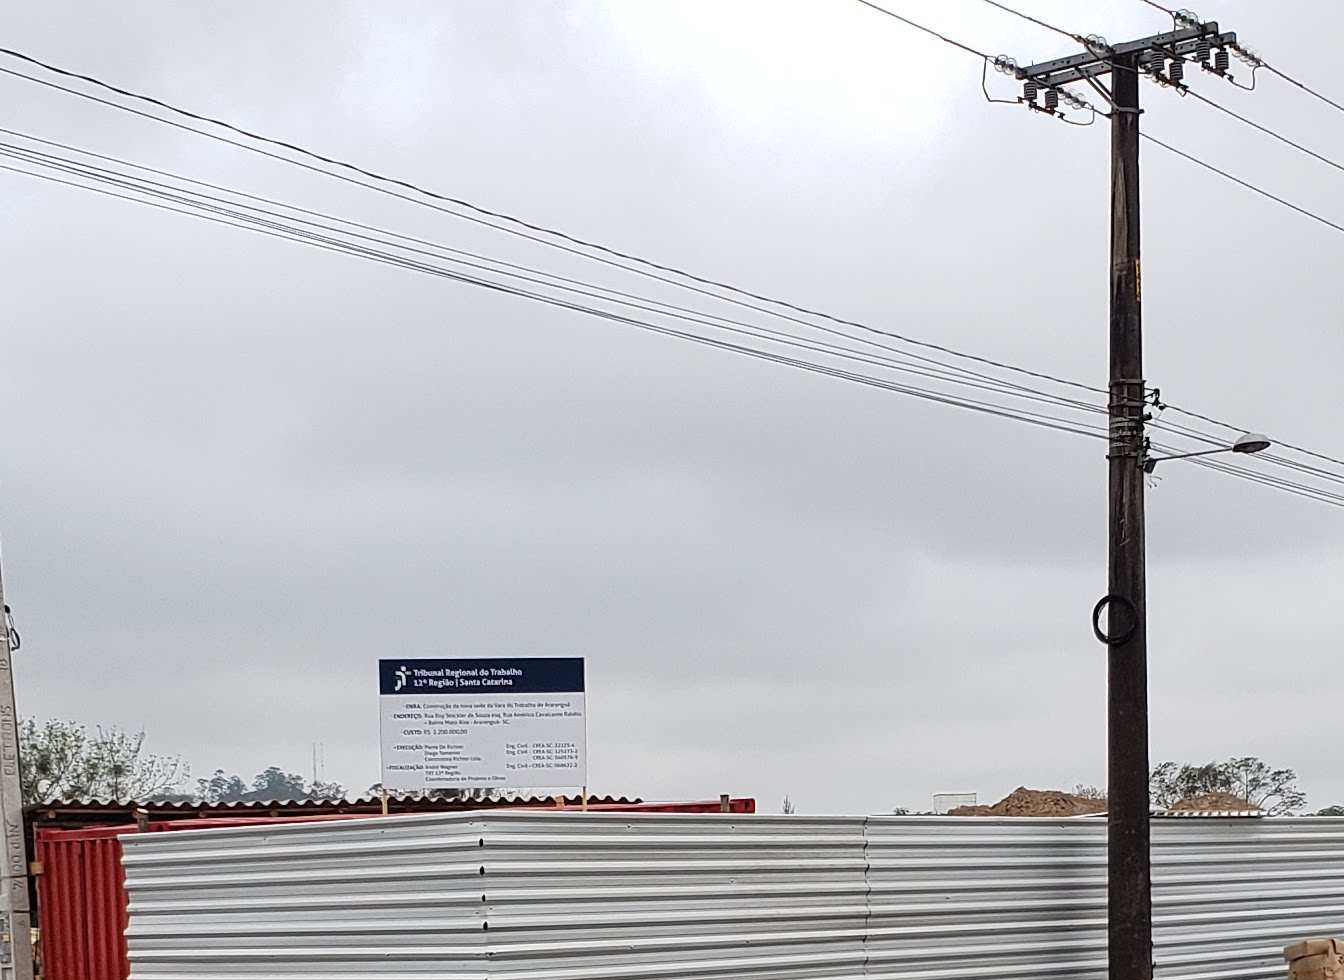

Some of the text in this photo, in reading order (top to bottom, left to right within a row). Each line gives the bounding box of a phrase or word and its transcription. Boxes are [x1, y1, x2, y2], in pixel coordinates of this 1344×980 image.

[413, 668, 522, 678] Tribunal Regional do Trabalho
[428, 678, 454, 689] Região
[459, 678, 480, 687] Santa
[481, 678, 513, 686] Catarina
